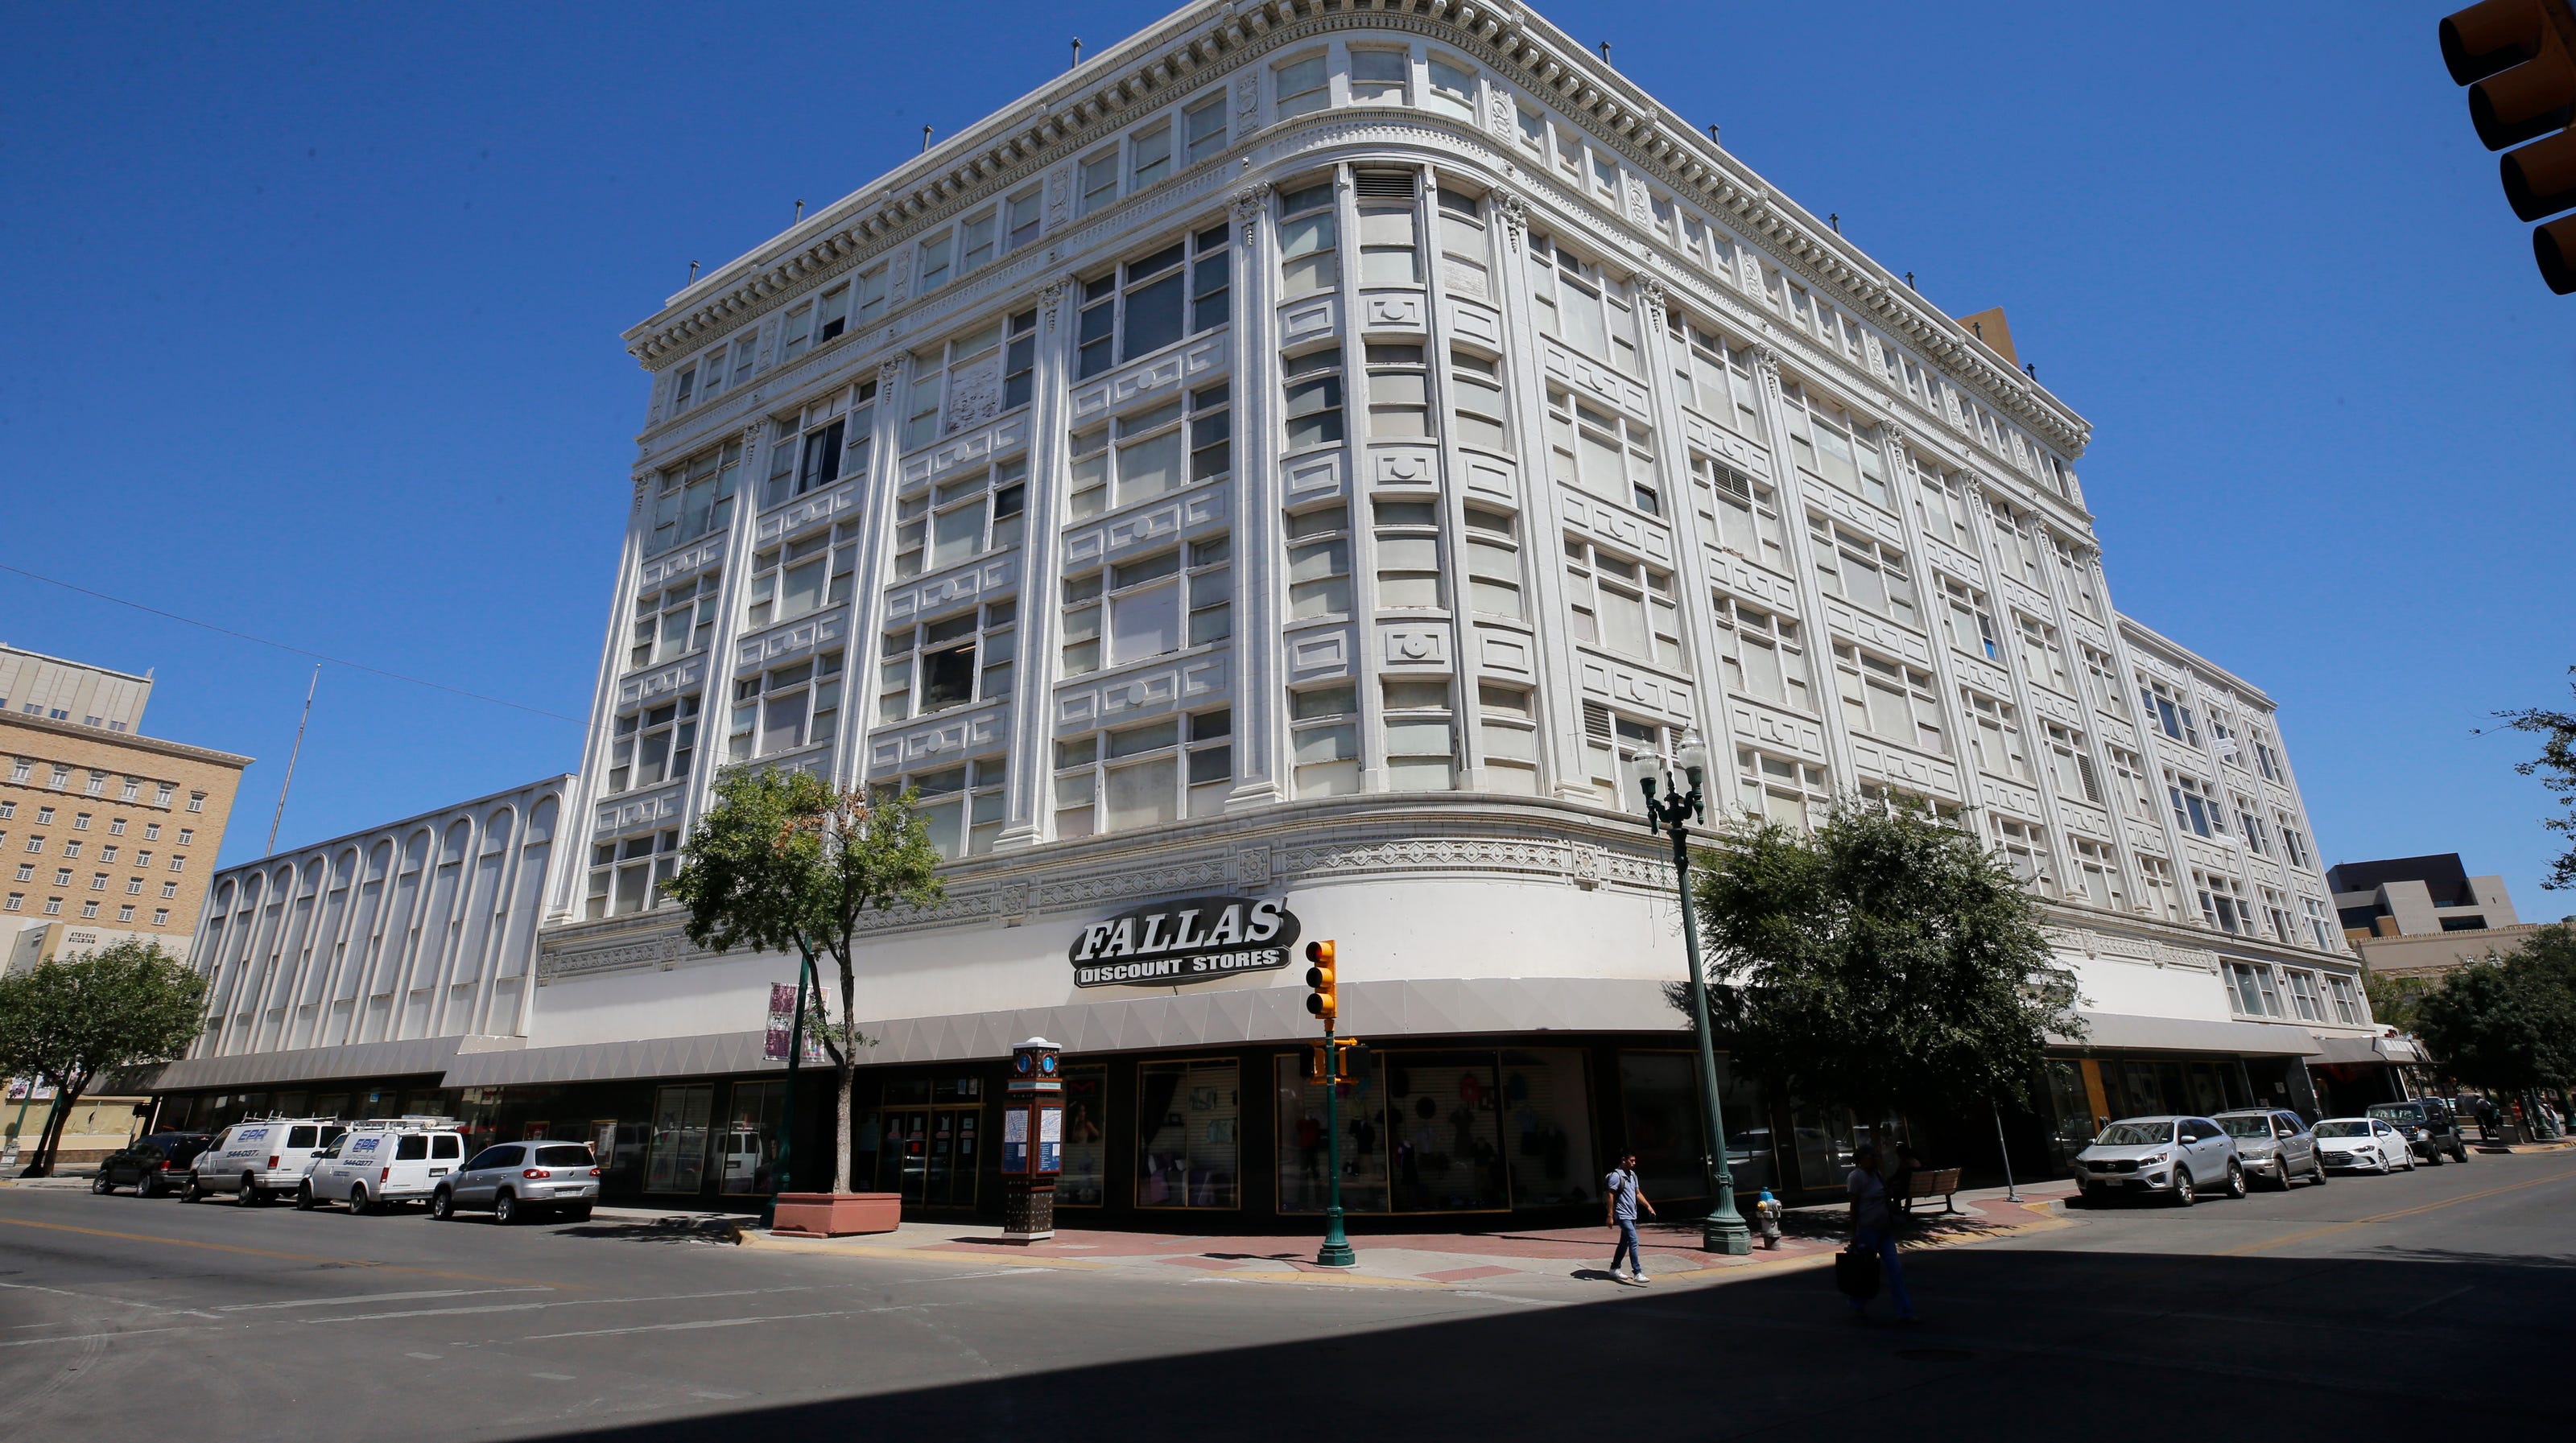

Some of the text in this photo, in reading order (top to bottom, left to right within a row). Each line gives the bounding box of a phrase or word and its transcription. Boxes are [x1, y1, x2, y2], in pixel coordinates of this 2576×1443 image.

[1075, 896, 1287, 961] FALLAS
[1080, 950, 1280, 983] DISCOUNT STORES
